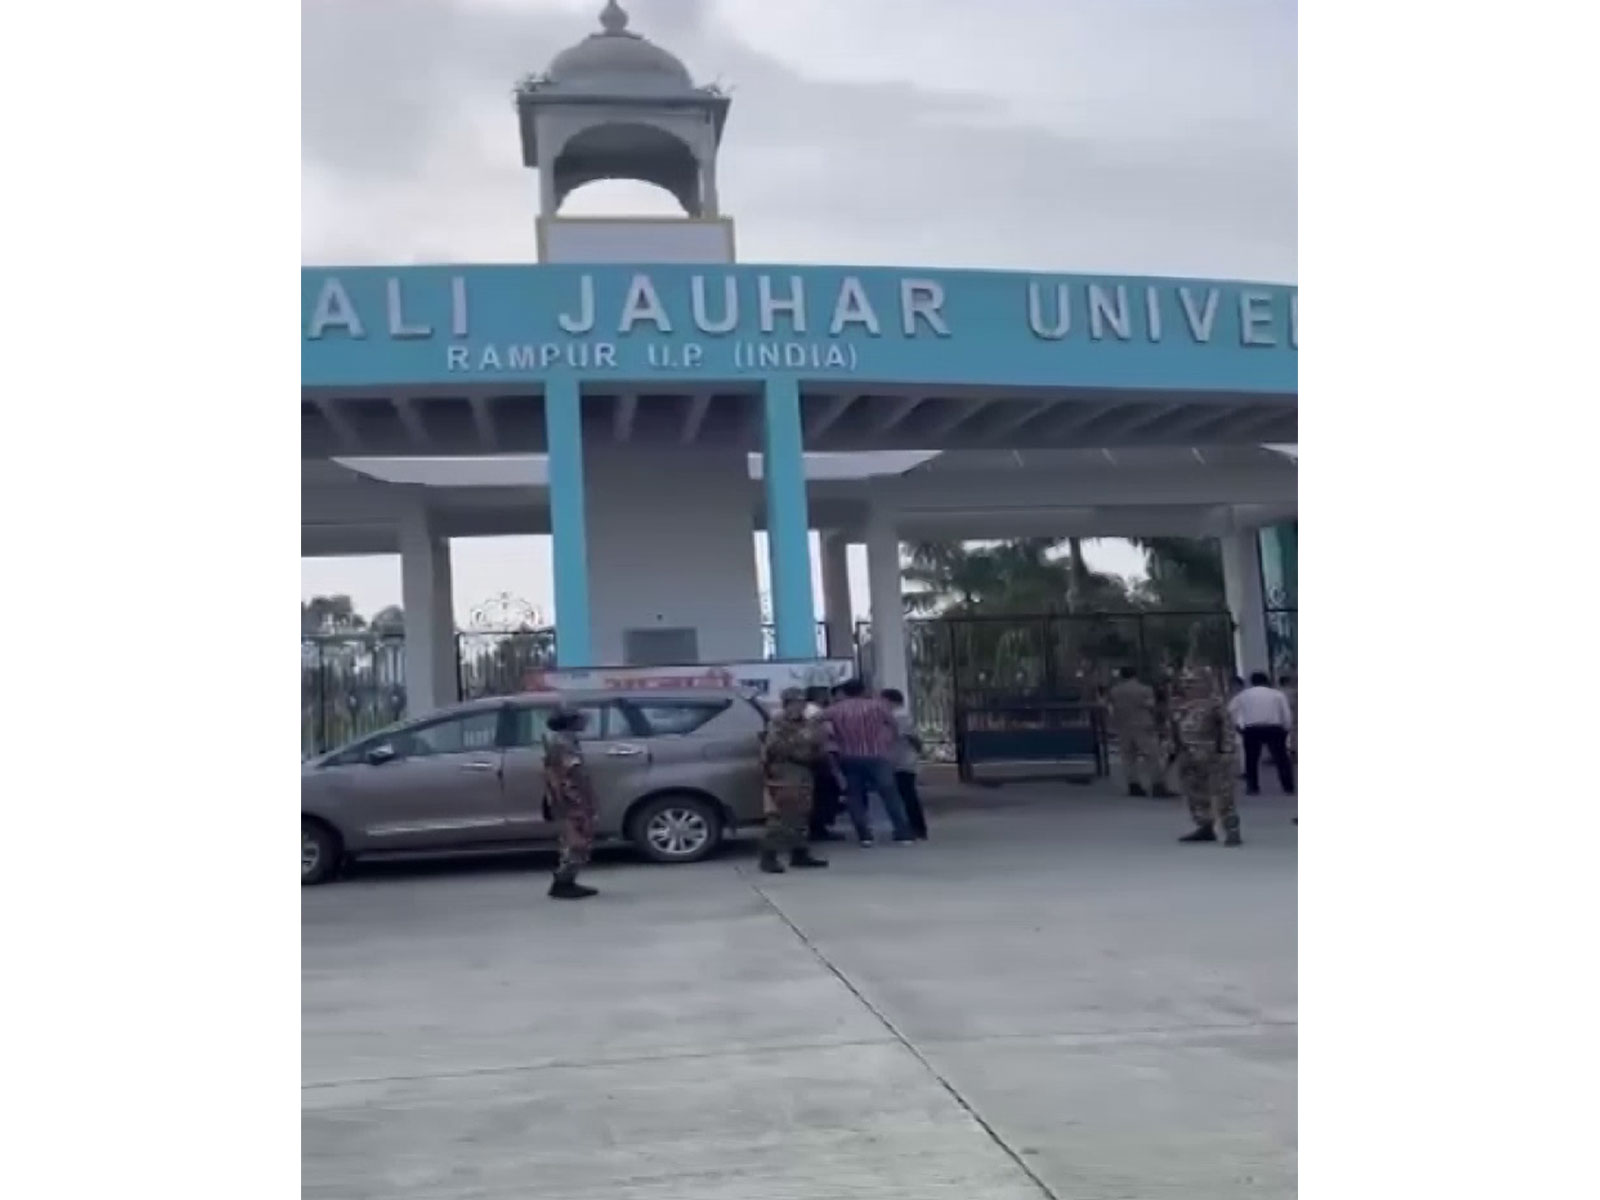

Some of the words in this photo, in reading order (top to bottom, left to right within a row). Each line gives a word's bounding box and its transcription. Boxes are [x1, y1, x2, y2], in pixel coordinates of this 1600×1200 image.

[307, 276, 468, 340] ALI
[558, 274, 953, 337] JAUHAR
[1027, 282, 1297, 349] UNIVE
[446, 342, 619, 371] RAMPUR
[733, 342, 860, 371] (INDIA)
